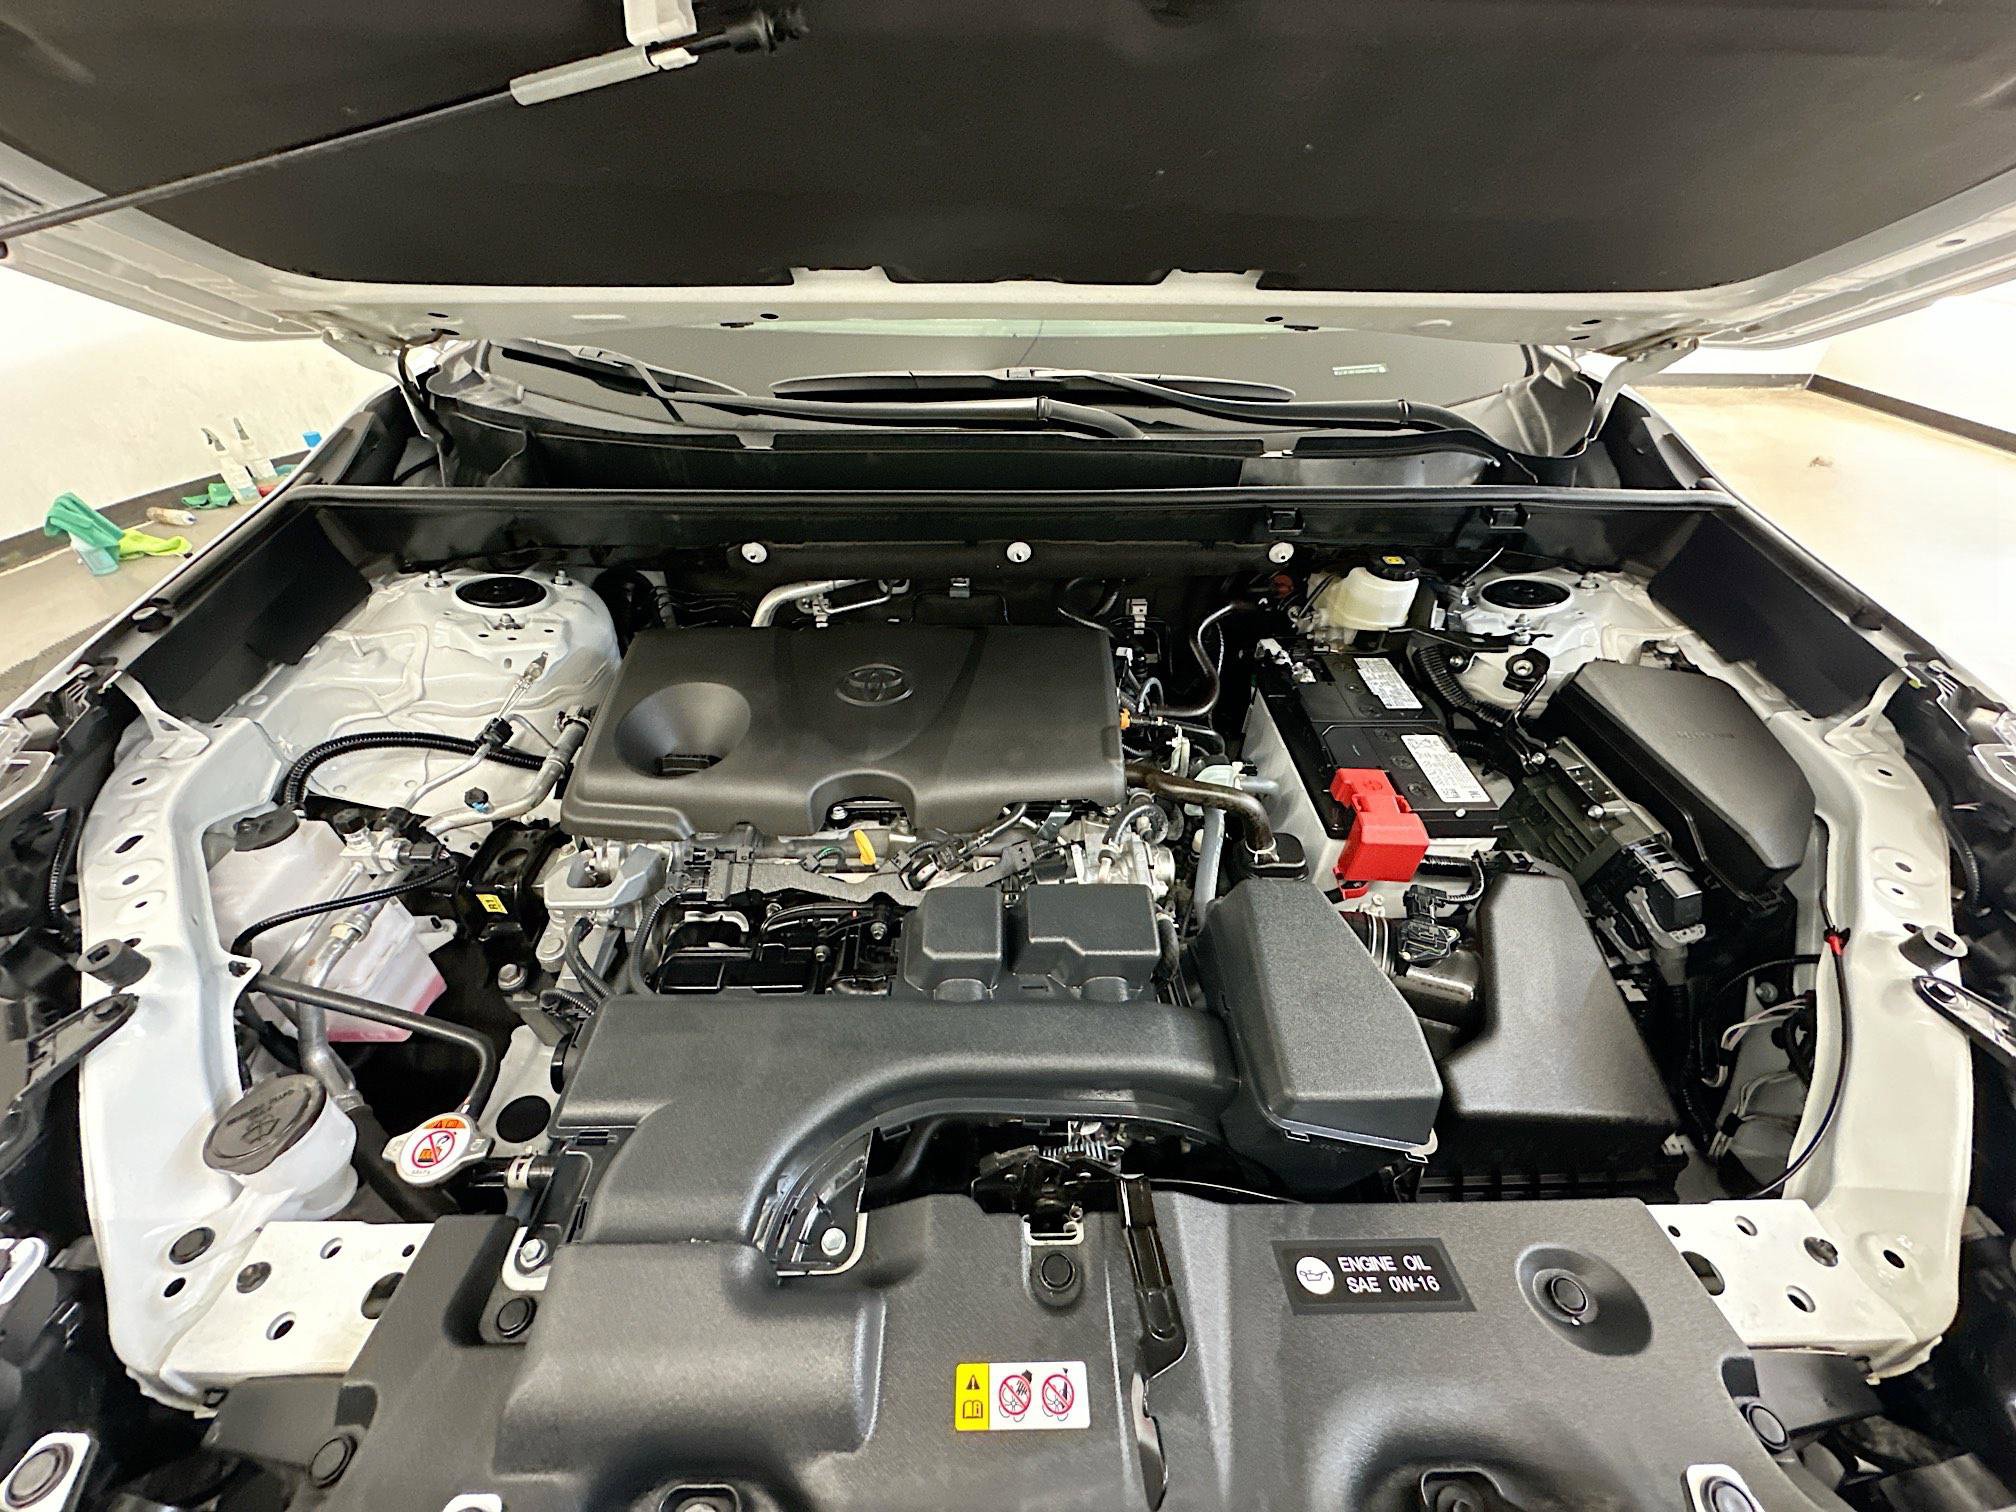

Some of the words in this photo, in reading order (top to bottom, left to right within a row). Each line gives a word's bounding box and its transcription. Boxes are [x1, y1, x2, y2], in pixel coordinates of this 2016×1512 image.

[1337, 1256, 1397, 1272] ENGINE
[1403, 1255, 1432, 1271] OIL
[1346, 1277, 1382, 1293] SAE
[1389, 1275, 1440, 1292] 0W-16
